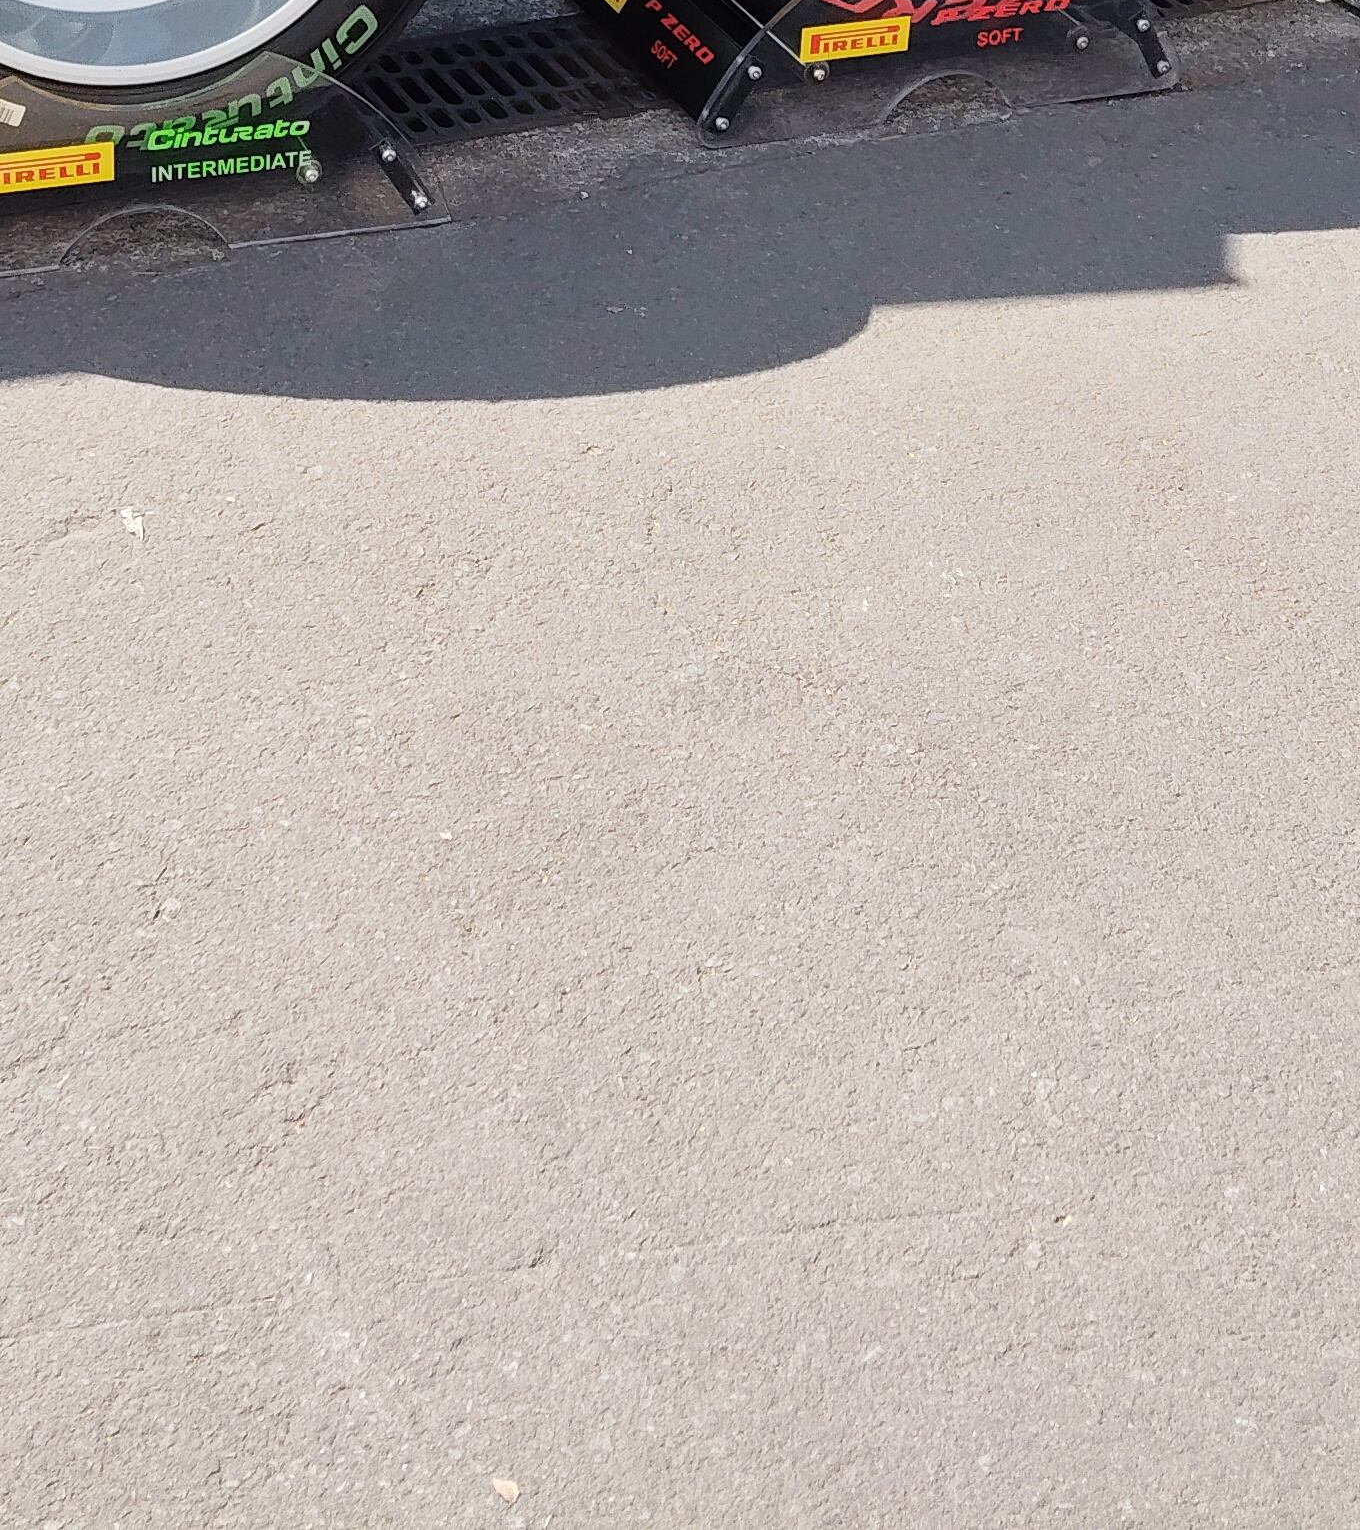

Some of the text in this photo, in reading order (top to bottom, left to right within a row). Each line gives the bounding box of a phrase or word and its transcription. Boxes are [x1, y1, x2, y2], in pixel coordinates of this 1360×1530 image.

[660, 12, 716, 66] ZERO
[809, 25, 901, 55] PIRELLI
[977, 27, 1024, 47] SOFT
[651, 40, 679, 69] SOFT
[146, 118, 311, 151] Cinturato
[151, 150, 312, 183] INTERMEDIATE
